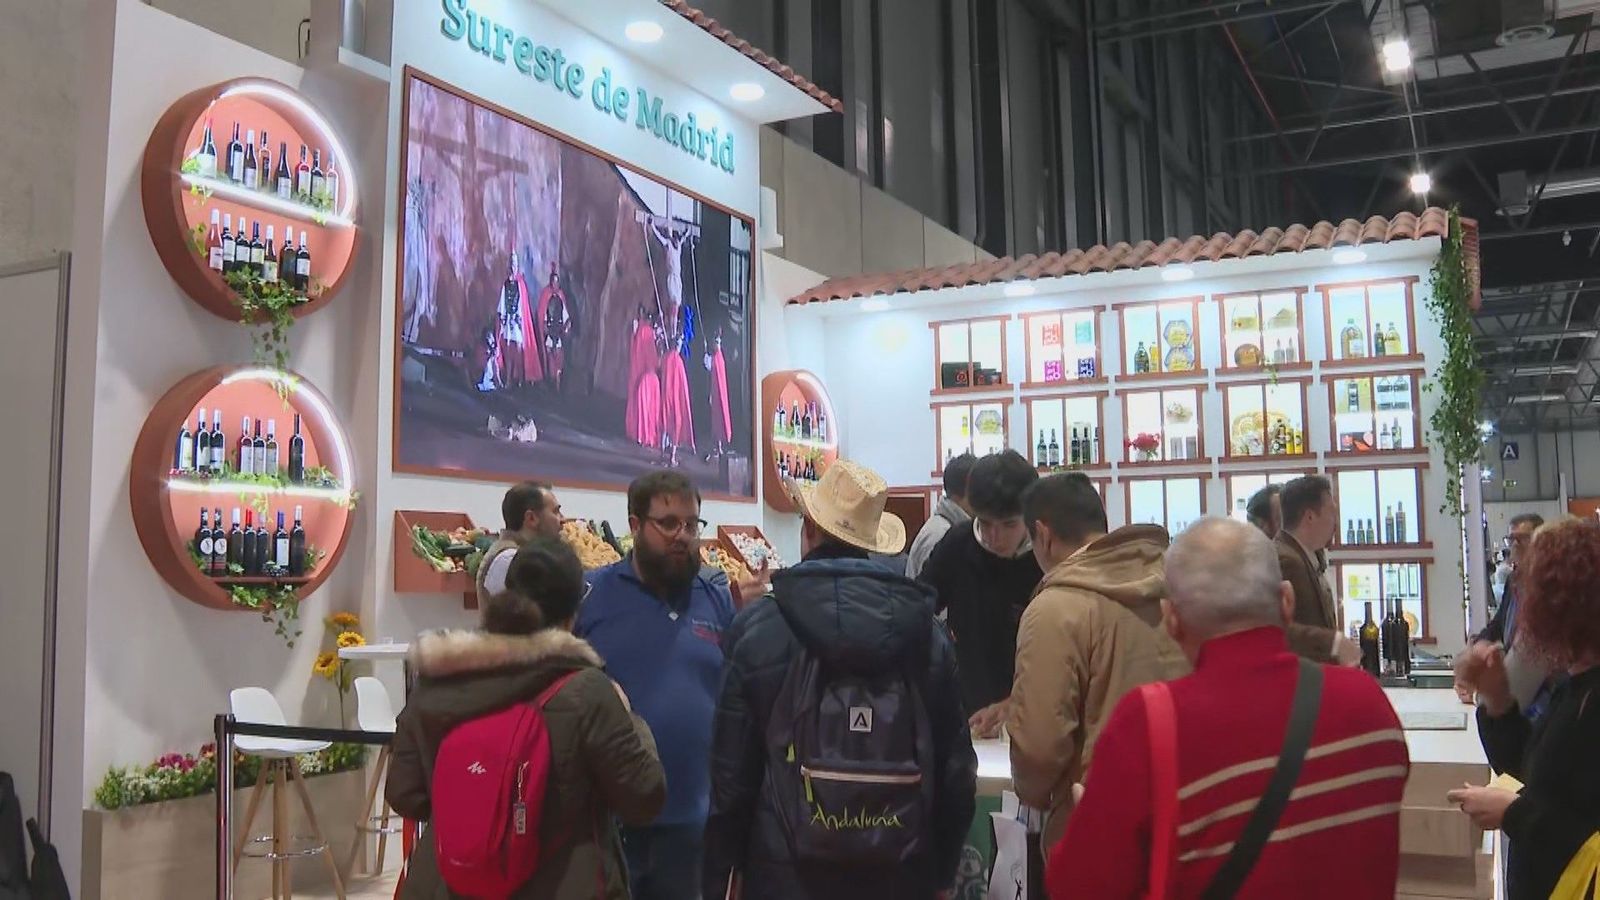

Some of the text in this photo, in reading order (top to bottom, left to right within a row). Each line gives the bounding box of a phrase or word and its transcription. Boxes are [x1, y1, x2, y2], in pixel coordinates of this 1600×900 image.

[441, 0, 736, 174] Sureste de Madrid
[1503, 445, 1516, 458] A
